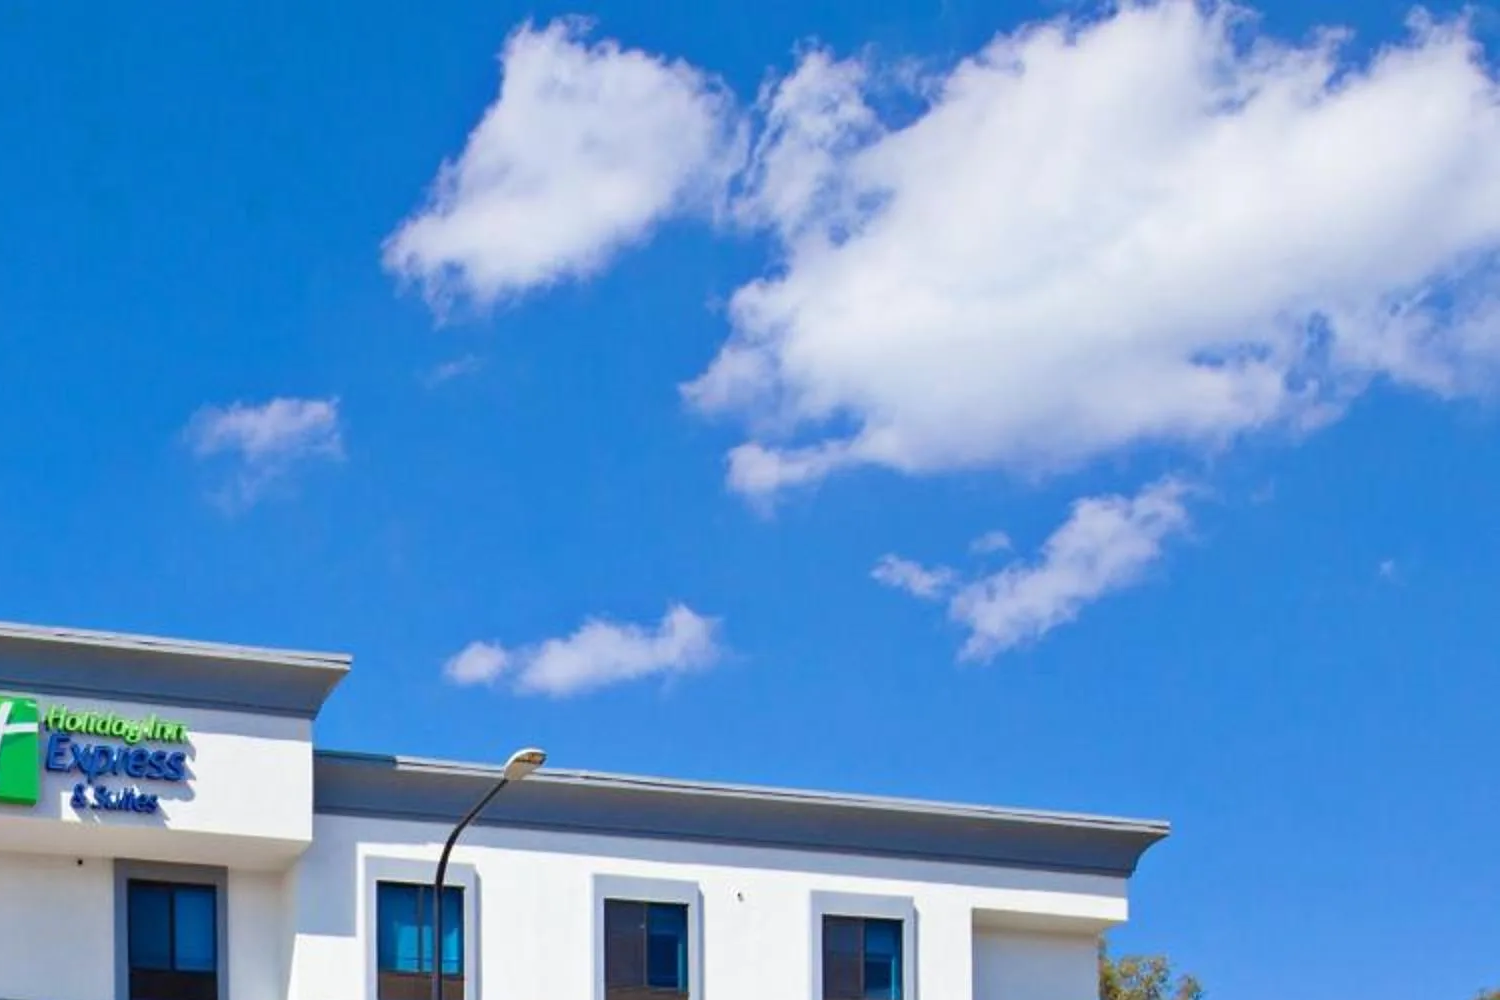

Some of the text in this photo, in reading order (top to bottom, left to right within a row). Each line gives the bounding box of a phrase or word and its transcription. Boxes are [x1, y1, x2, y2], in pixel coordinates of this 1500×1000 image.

[45, 704, 187, 745] Holiday Inn
[46, 732, 186, 783] Express
[70, 783, 159, 813] & Suites
